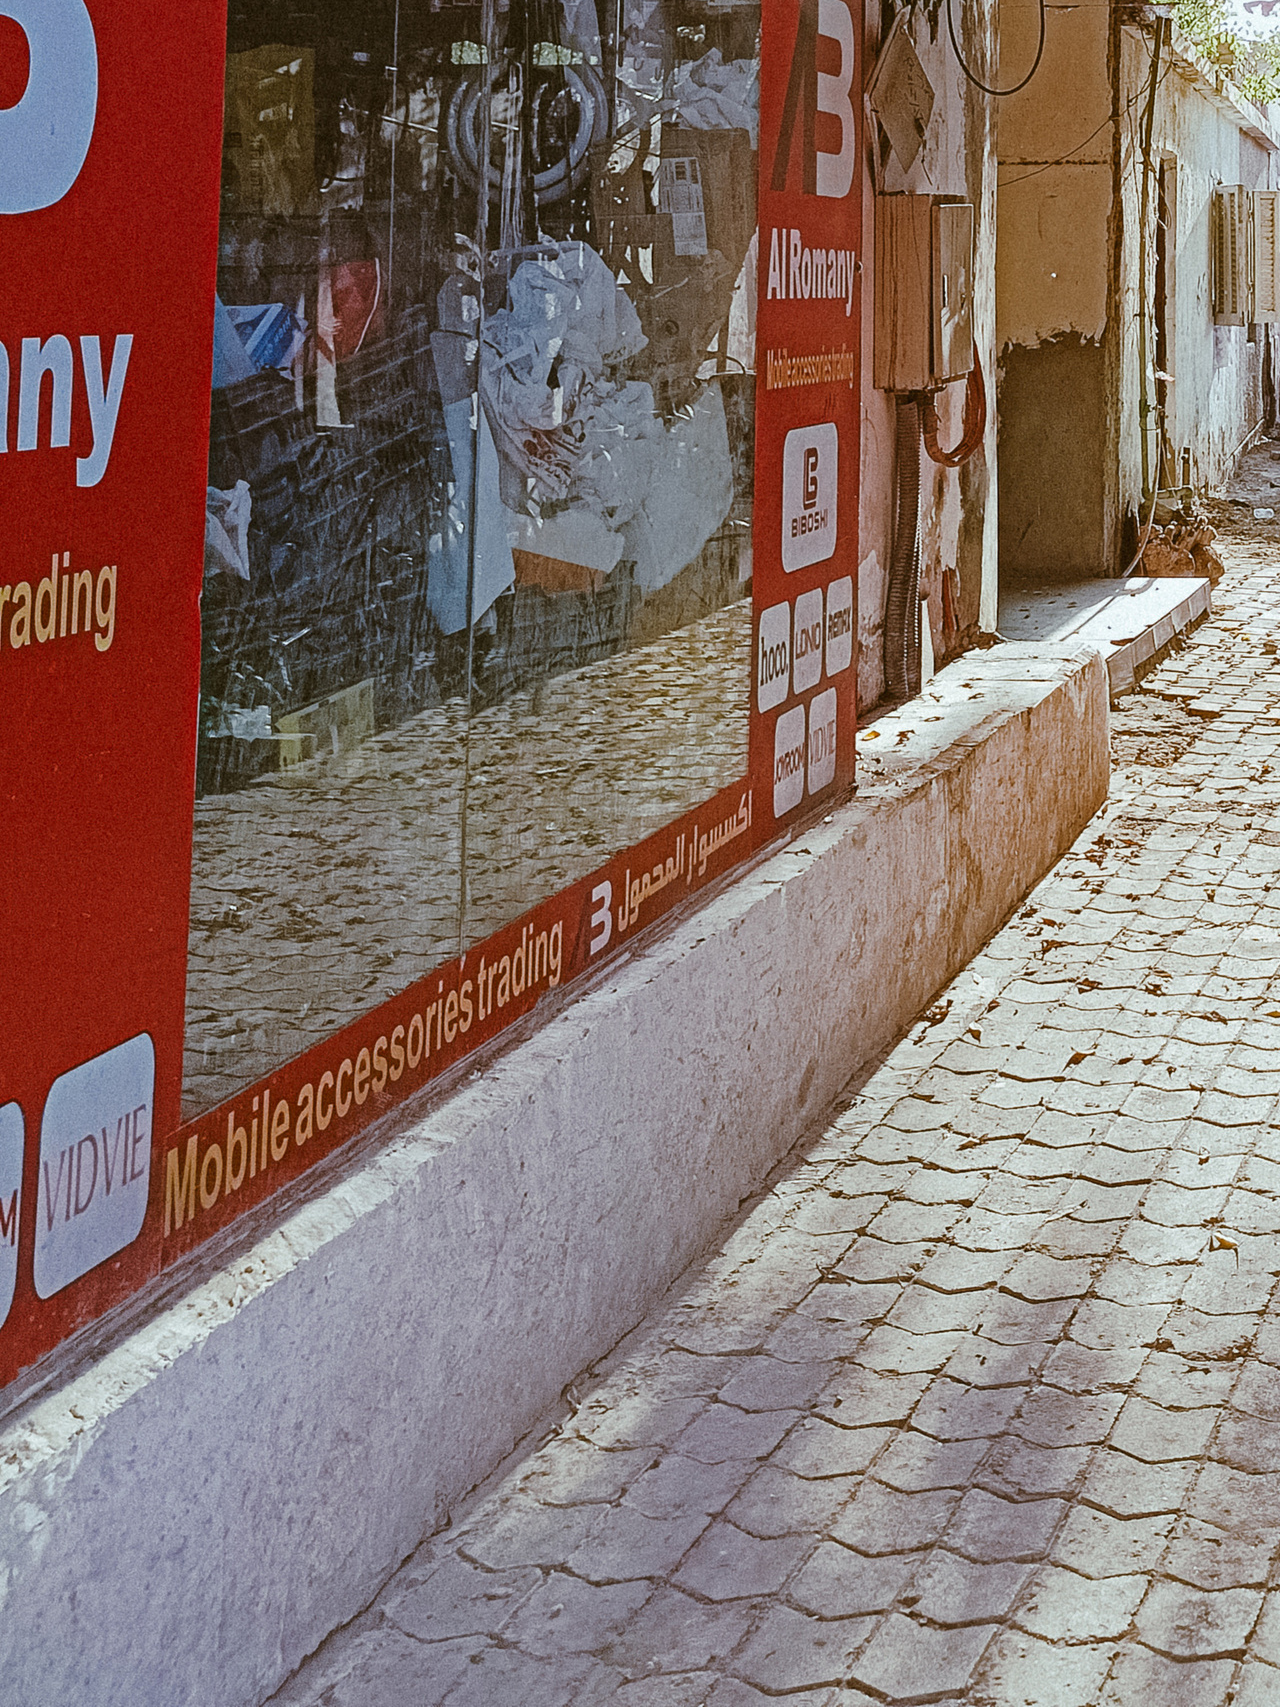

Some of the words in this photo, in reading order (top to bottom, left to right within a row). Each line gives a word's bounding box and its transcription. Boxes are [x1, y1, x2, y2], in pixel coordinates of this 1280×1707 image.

[789, 228, 856, 318] Romany
[0, 333, 134, 488] ny
[791, 508, 829, 538] BIBOSHI
[617, 833, 686, 933] المحمول
[686, 789, 753, 886] اكسسوار
[163, 1089, 290, 1239] Mobile
[295, 979, 473, 1147] accessories
[477, 920, 563, 1022] trading
[42, 1103, 147, 1233] VIDVIE
